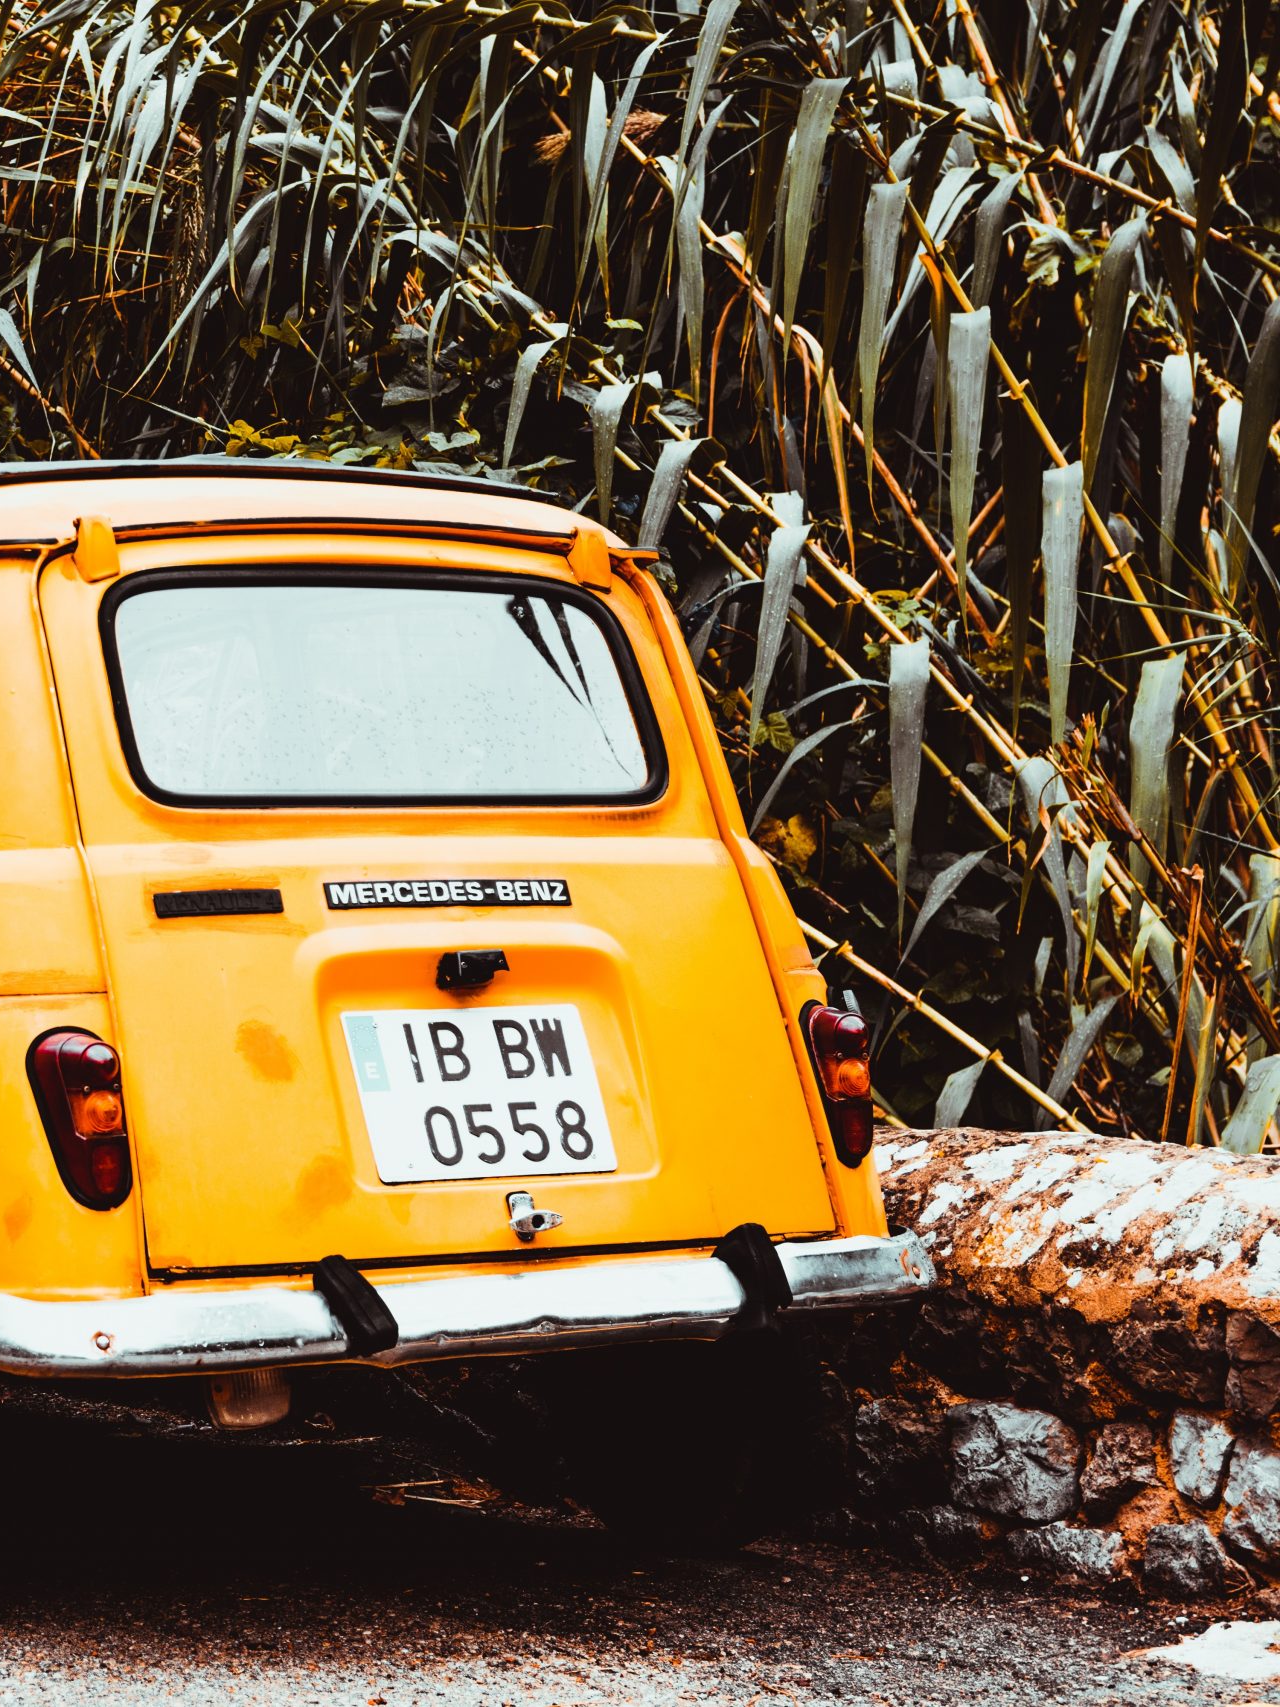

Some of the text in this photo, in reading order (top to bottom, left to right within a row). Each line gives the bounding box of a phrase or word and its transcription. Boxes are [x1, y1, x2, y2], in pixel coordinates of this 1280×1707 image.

[329, 881, 568, 905] MERCEDES-BENZ
[363, 1061, 381, 1079] E
[402, 1018, 572, 1083] IB BW
[424, 1100, 594, 1166] 0558
